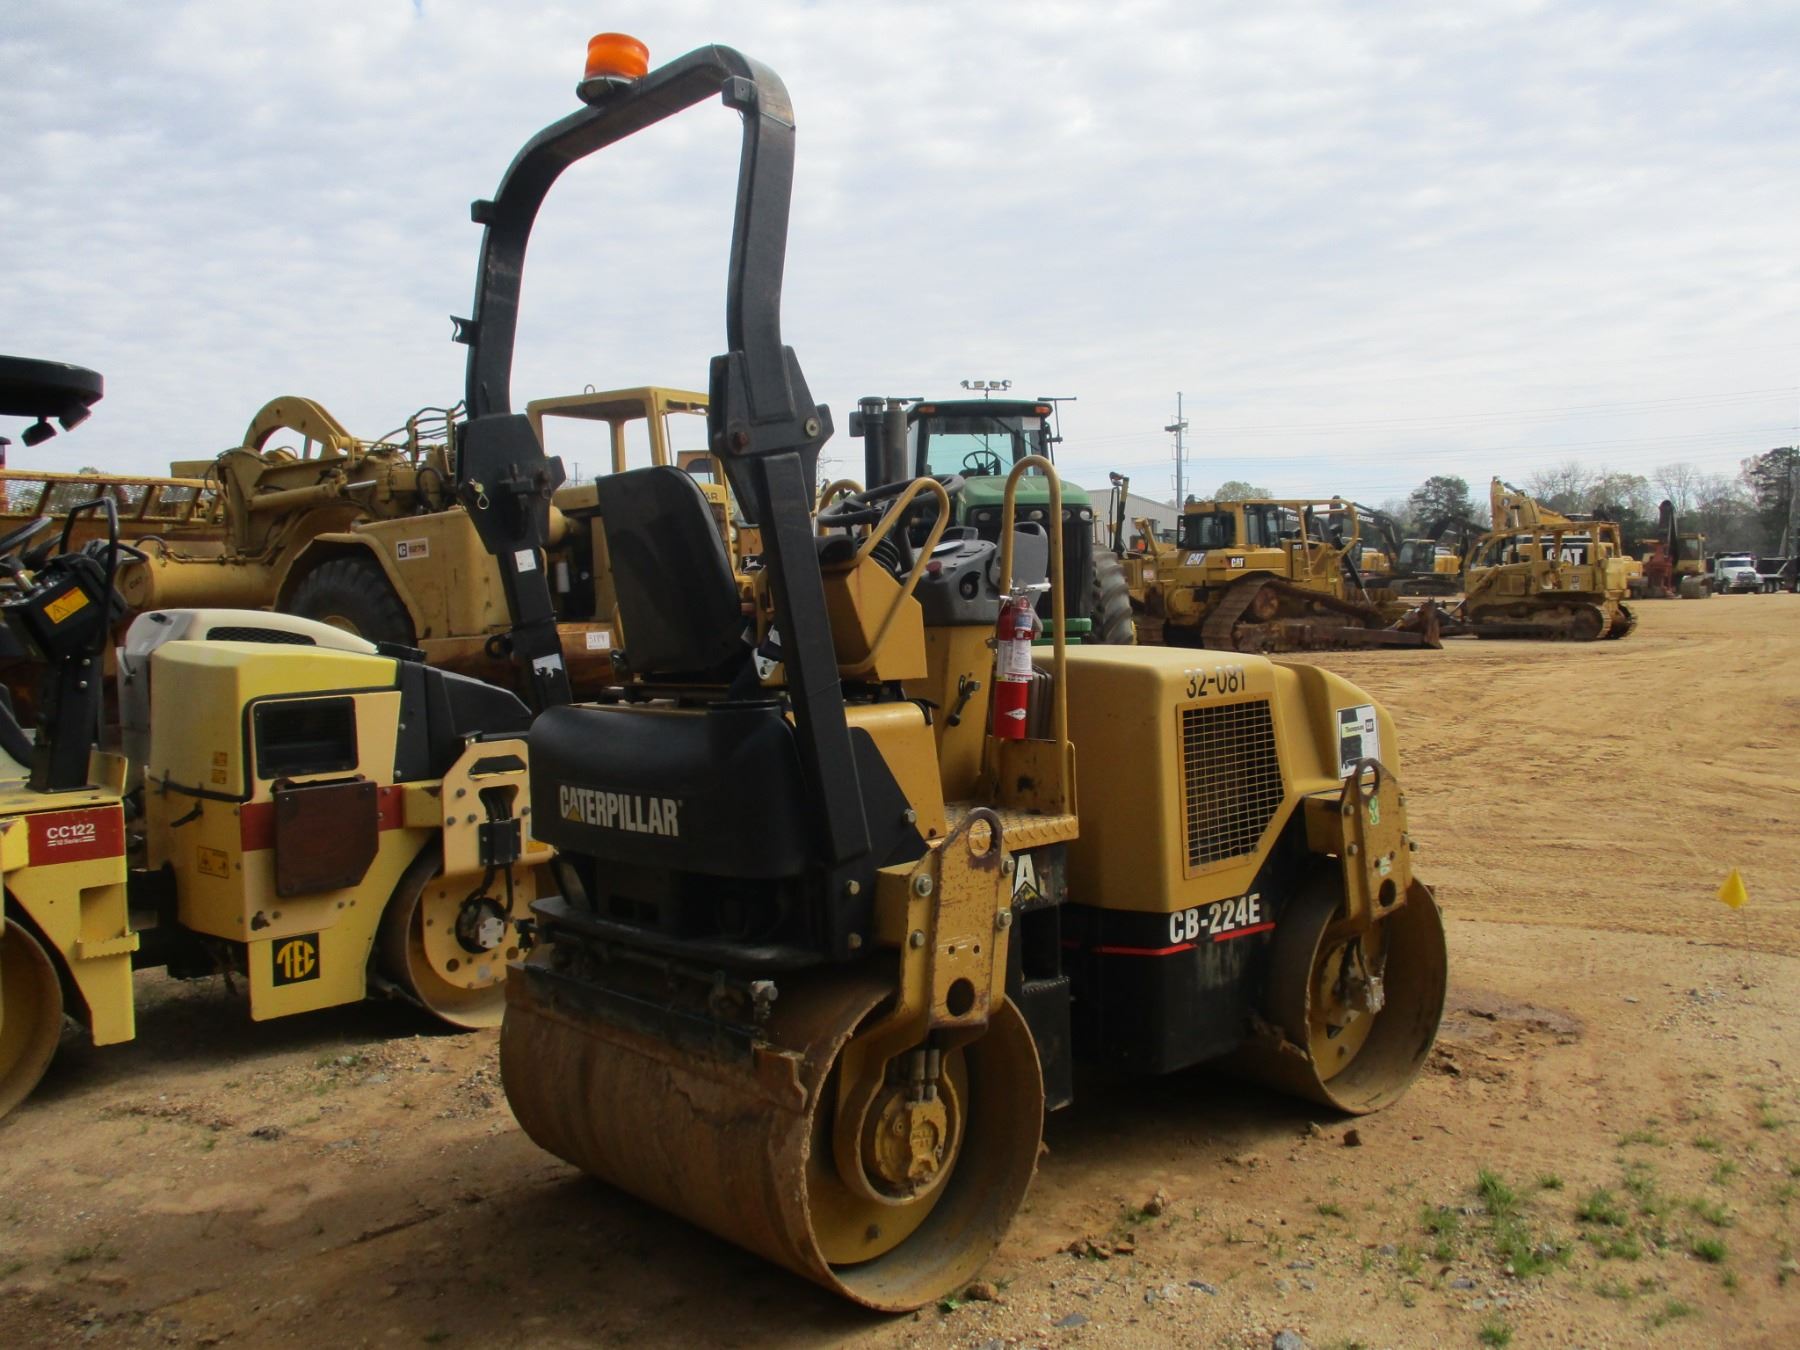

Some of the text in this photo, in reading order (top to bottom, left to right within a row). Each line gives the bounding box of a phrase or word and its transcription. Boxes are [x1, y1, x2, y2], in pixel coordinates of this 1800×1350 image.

[1187, 552, 1205, 565] CAT
[1231, 557, 1245, 567] CAT
[1184, 664, 1245, 698] 32-081
[560, 784, 679, 837] CATERPILLAR
[46, 823, 96, 839] CC122
[1169, 893, 1261, 944] CB-224E
